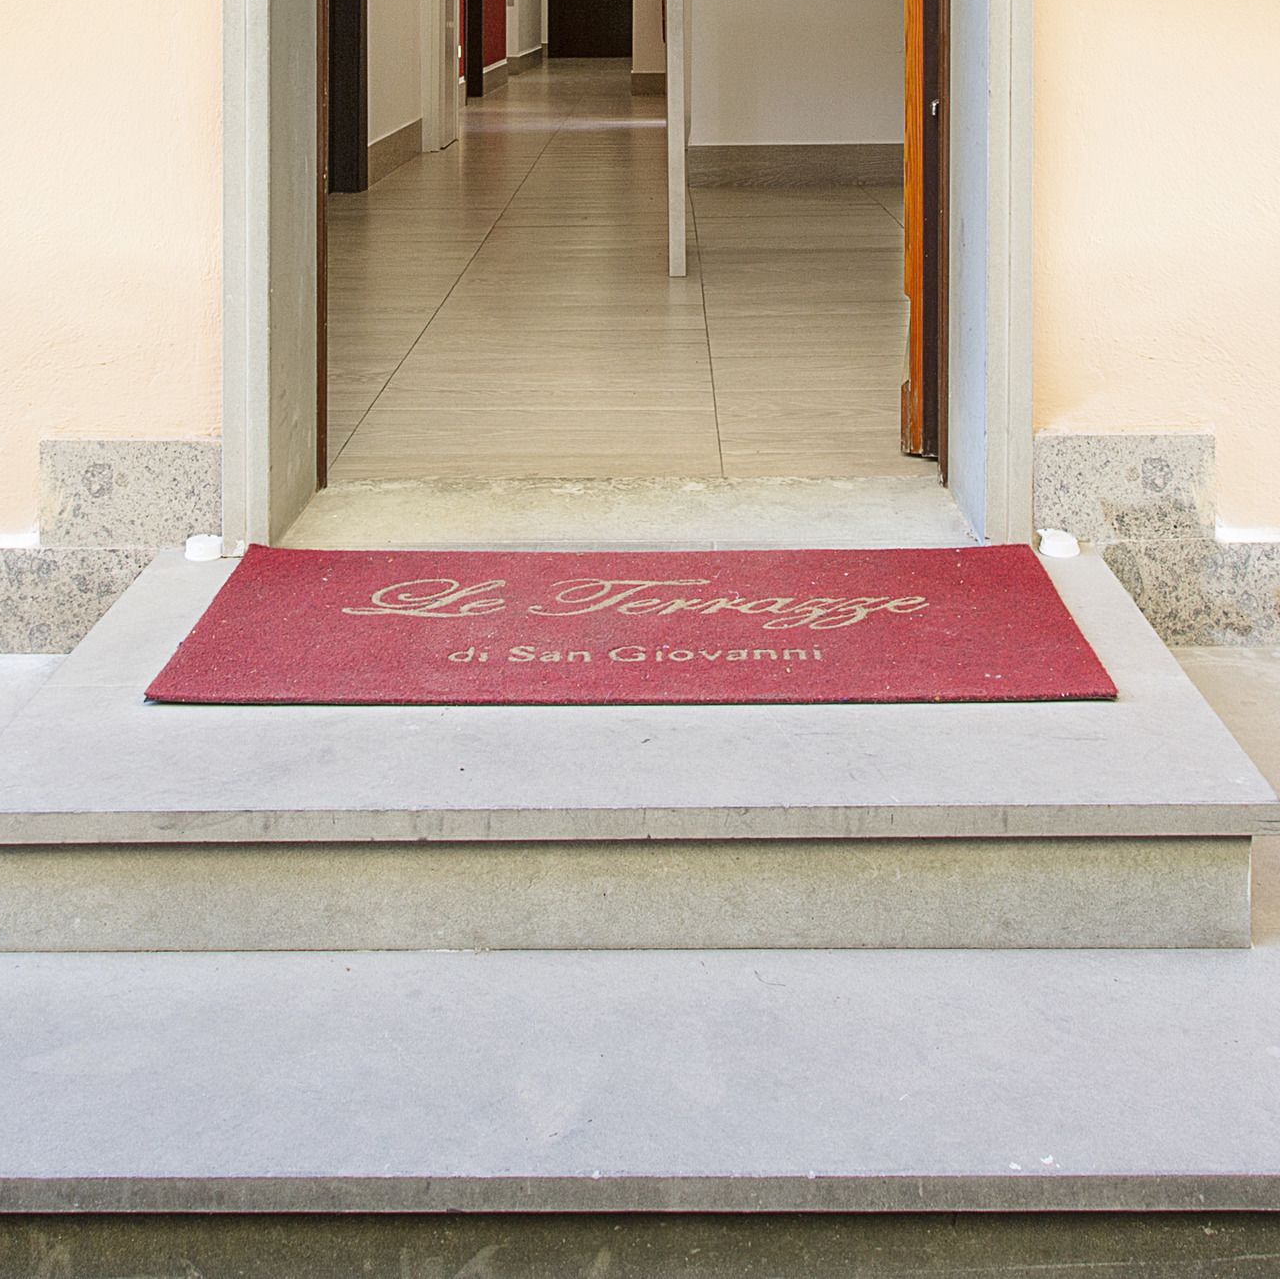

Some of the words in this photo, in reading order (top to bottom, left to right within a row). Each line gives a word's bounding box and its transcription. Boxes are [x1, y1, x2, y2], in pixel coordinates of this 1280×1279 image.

[341, 578, 507, 618] Le
[527, 578, 931, 630] Terrazze
[447, 646, 490, 663] di
[507, 645, 592, 663] San
[608, 645, 822, 663] Giovanni
